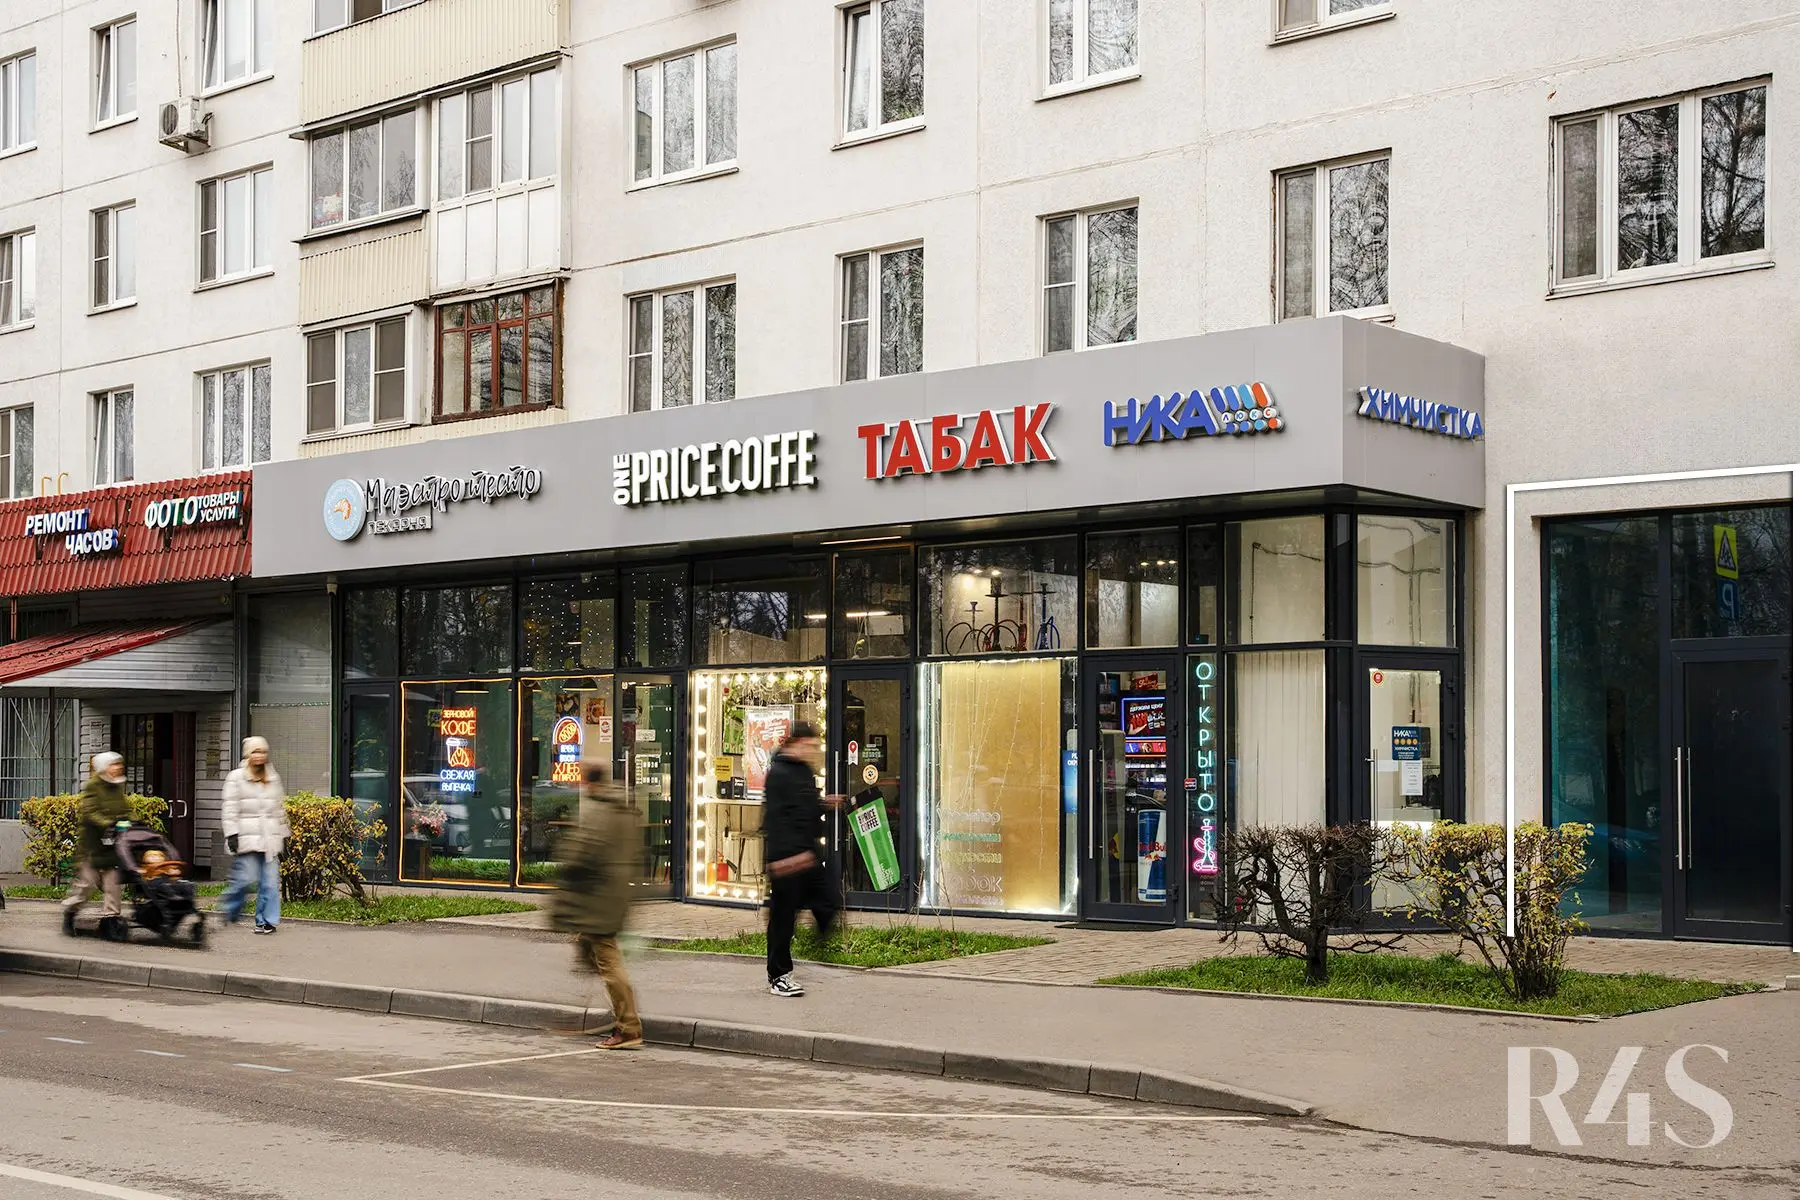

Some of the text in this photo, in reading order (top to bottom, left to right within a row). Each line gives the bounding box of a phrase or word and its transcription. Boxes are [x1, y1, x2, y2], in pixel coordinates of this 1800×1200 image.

[1103, 389, 1217, 447] НИКА
[1222, 408, 1272, 422] ЛЮКС
[1364, 386, 1484, 438] ХИМЧИСТКА
[857, 402, 1056, 480] ТАБАК
[365, 465, 542, 515] Маэстро тесто
[612, 453, 631, 505] ONE
[24, 508, 88, 535] РЕМОНТ
[144, 490, 241, 530] ФОТО ТОВАРЫ
[200, 505, 237, 523] УСЛУГИ
[65, 528, 117, 556] ЧАСОВ
[443, 707, 475, 718] ЗЕРНОВОЙ
[441, 720, 476, 736] КОФЕ
[1195, 662, 1214, 812] ОТКРЫТО
[440, 769, 475, 781] СВЕЖАЯ
[555, 762, 580, 774] ХЛЕБ
[441, 782, 473, 792] ВЫПЕЧКА
